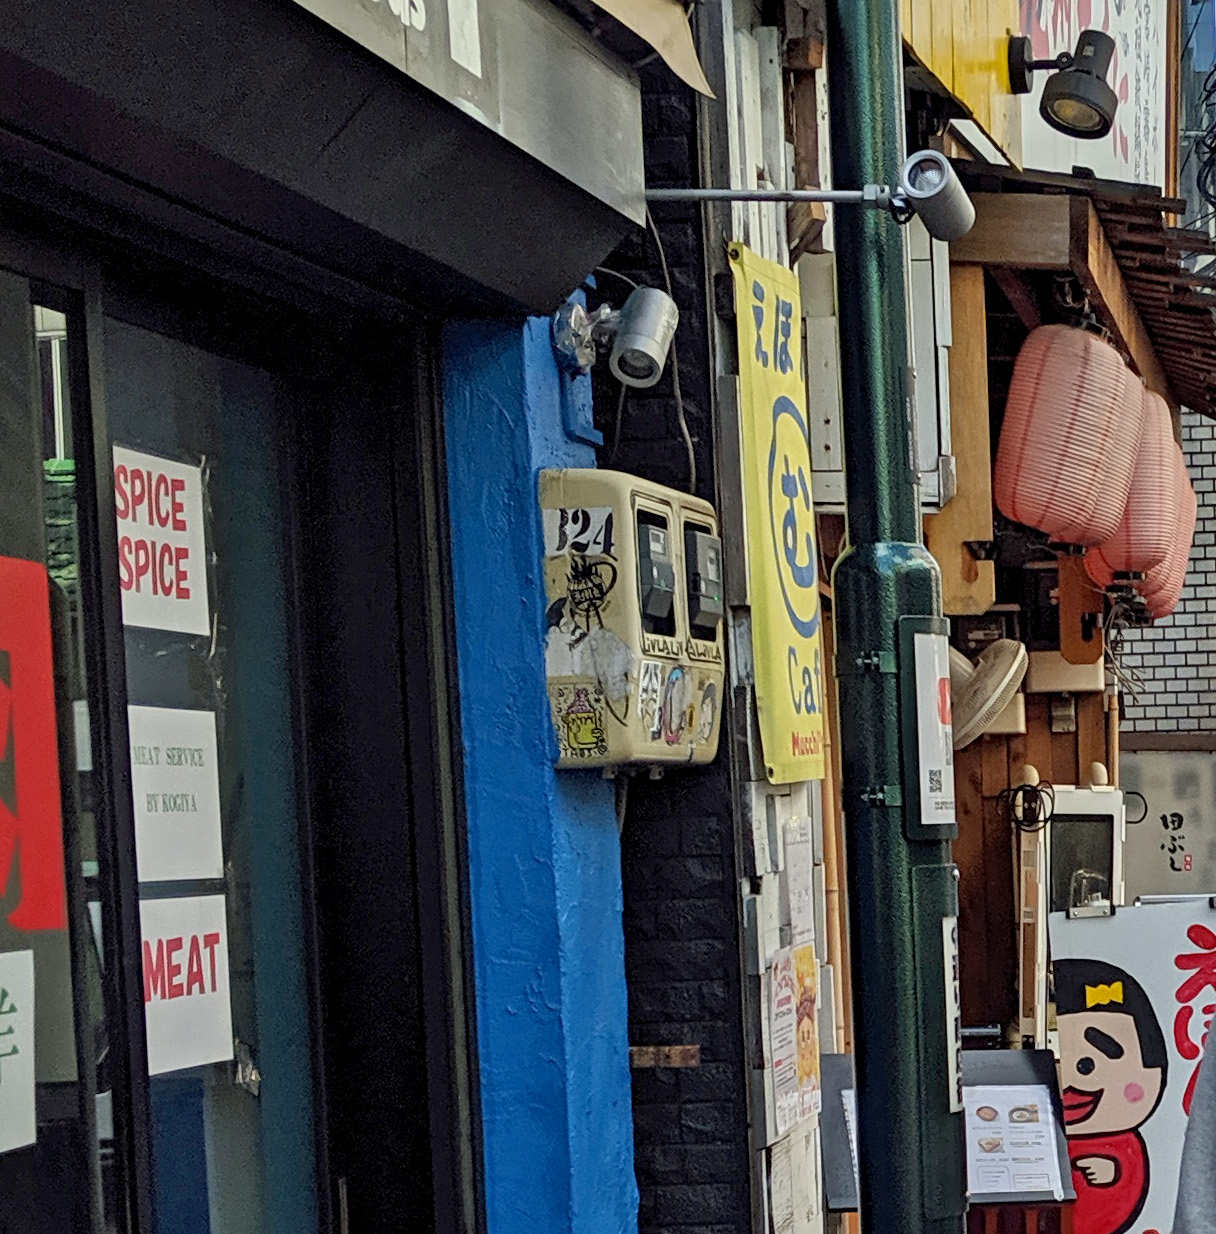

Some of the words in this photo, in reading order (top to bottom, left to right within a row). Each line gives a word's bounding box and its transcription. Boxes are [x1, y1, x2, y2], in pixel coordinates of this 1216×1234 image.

[114, 463, 187, 532] SPICE
[119, 535, 191, 600] SPICE
[132, 745, 161, 766] MEAT
[165, 747, 204, 767] SERVICE
[145, 793, 159, 813] BY
[1159, 811, 1186, 872] 田ぶし
[143, 931, 221, 1003] MEAT
